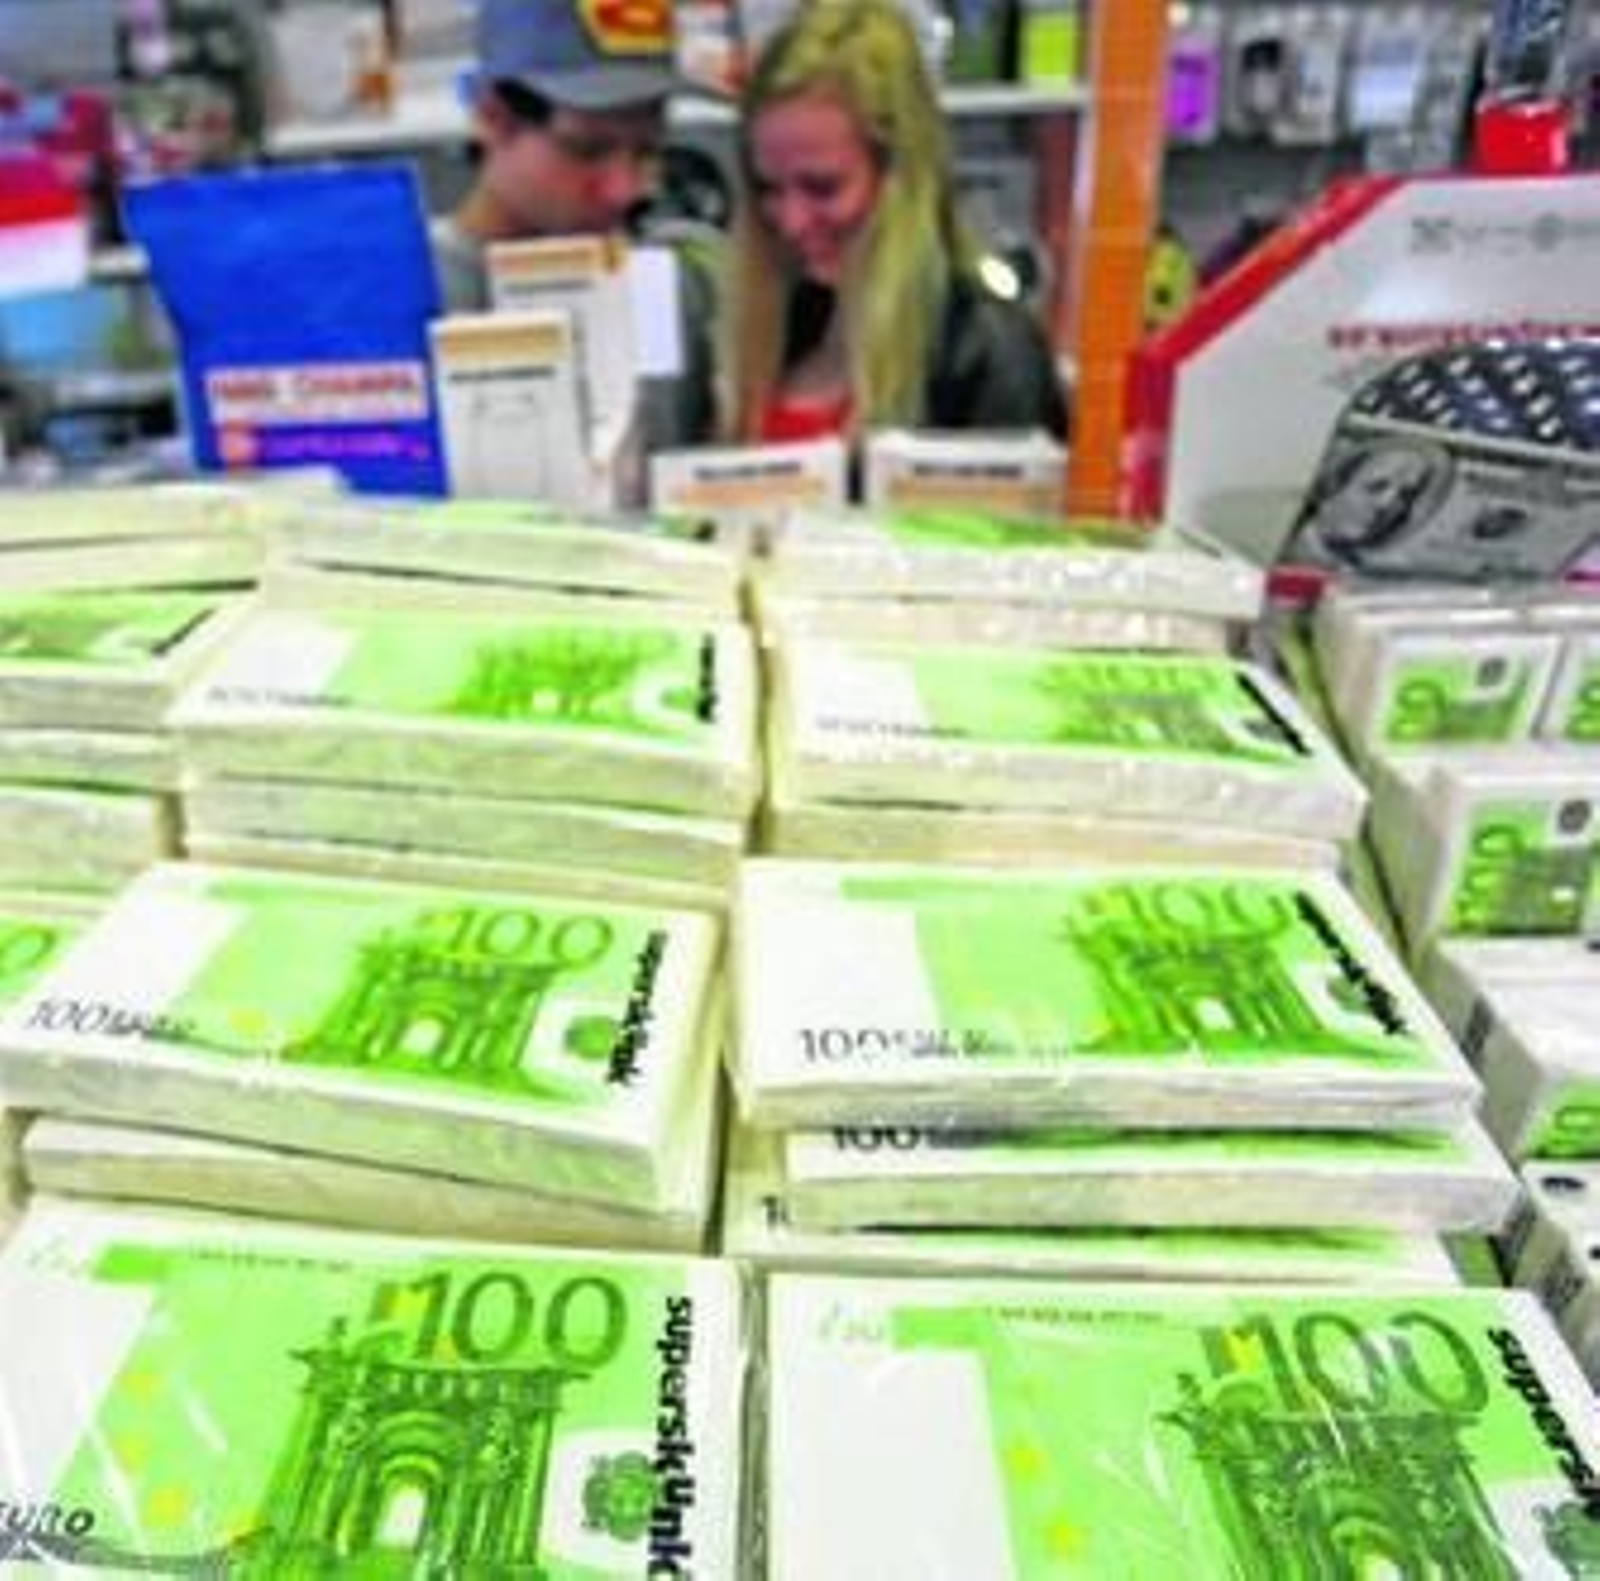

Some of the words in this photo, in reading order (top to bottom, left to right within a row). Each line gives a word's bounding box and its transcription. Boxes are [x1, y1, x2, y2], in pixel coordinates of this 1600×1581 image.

[452, 906, 614, 972] 100
[411, 1270, 628, 1369] 100
[1233, 1312, 1490, 1412] 100
